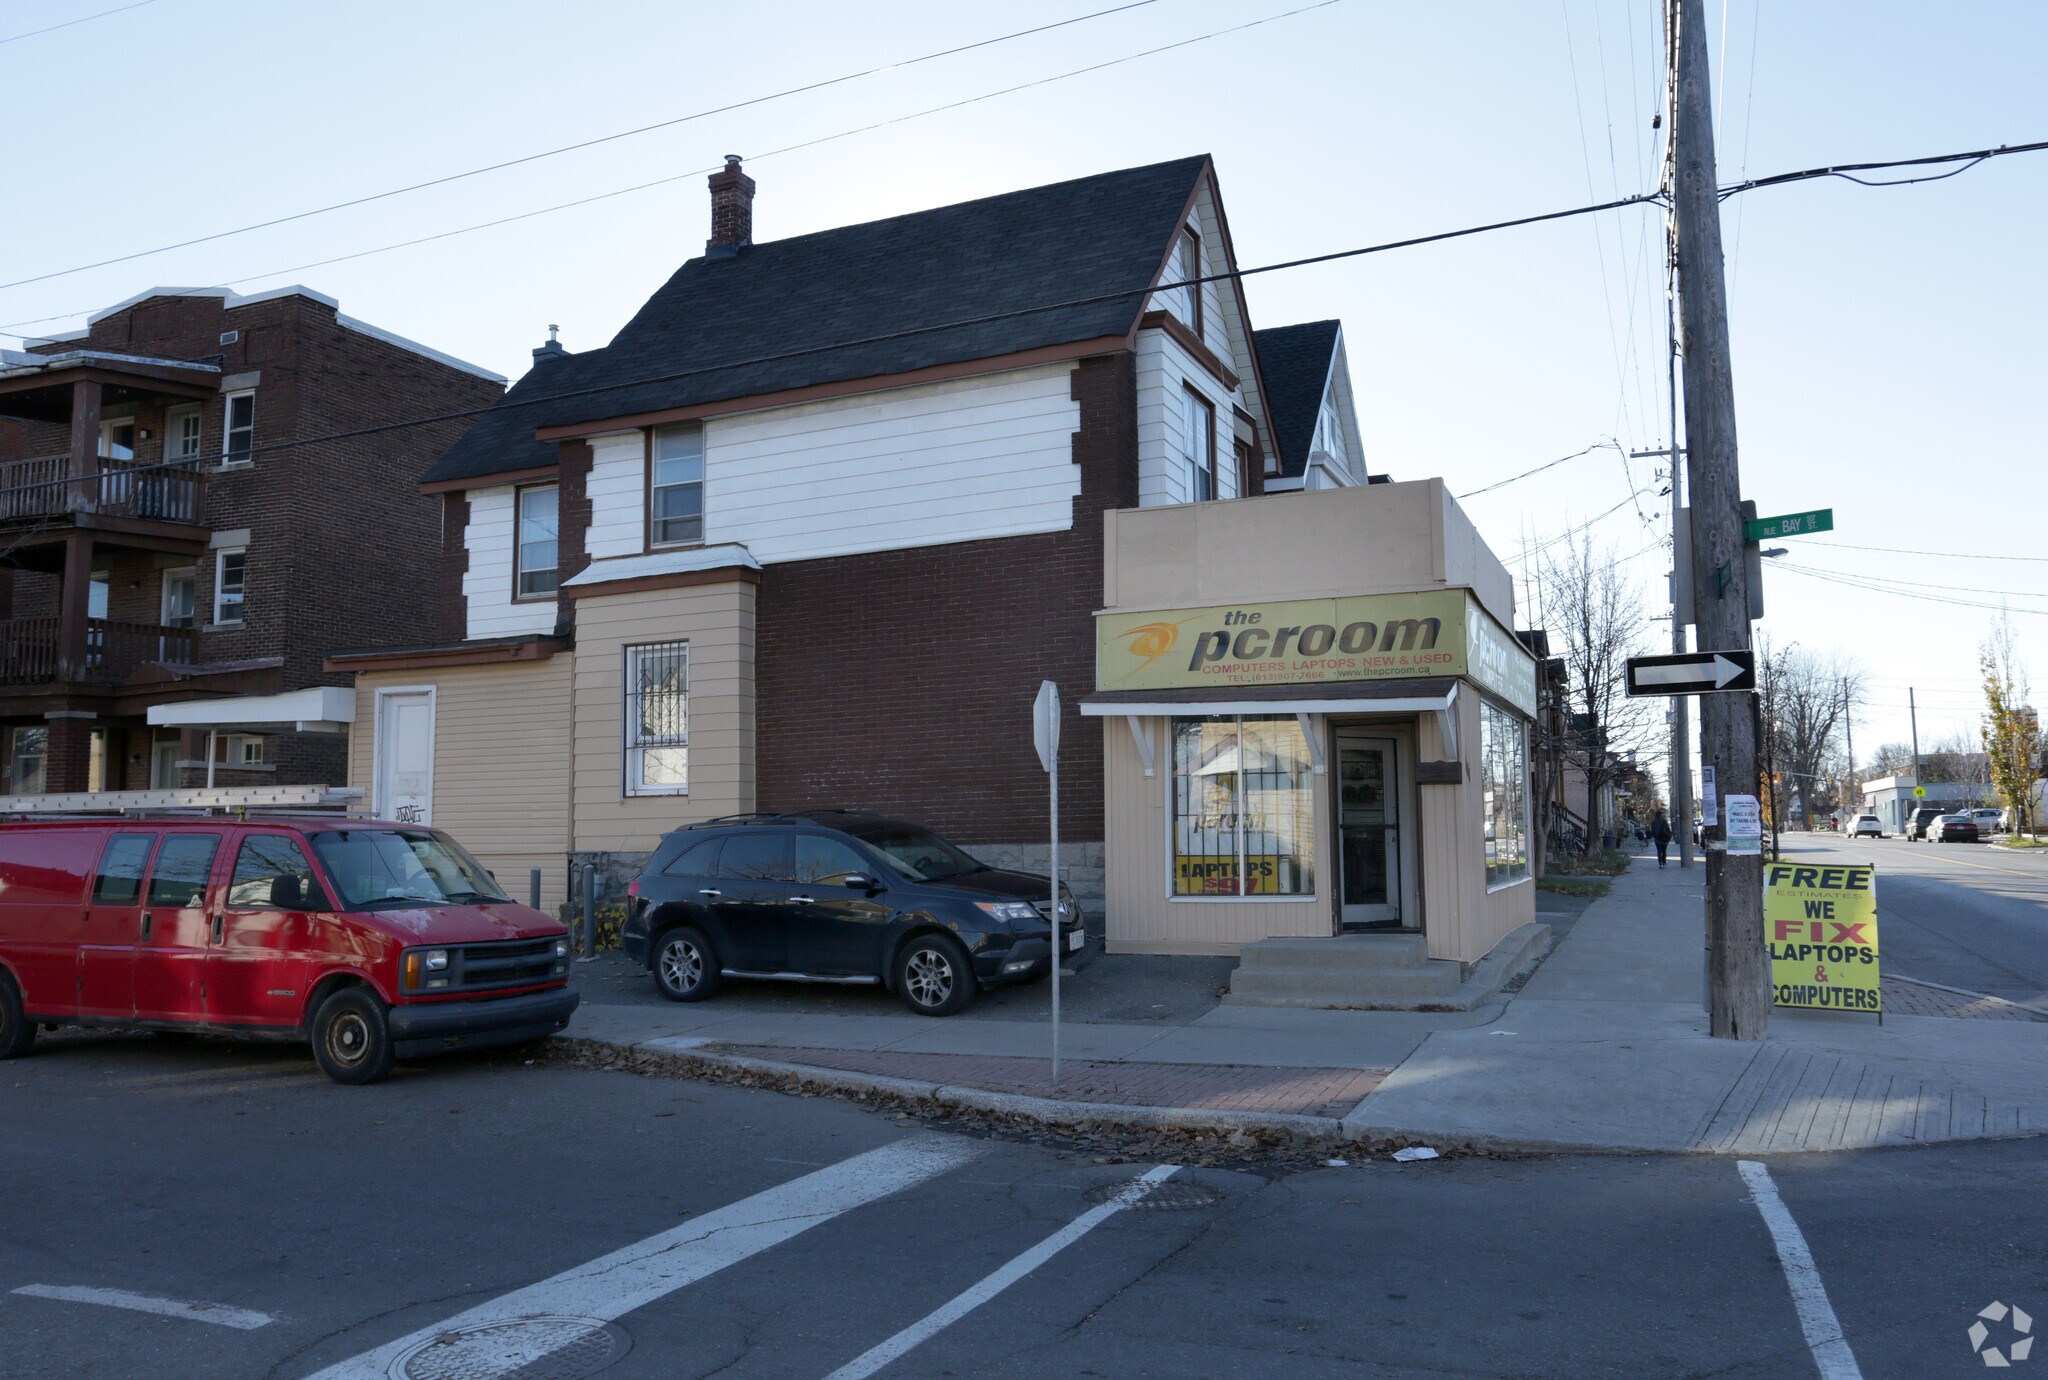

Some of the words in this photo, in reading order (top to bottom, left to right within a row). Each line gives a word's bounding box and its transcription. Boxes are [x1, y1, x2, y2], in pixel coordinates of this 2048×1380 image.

[1764, 527, 1776, 535] RUE
[1782, 518, 1801, 533] BAY
[1224, 610, 1262, 625] the
[1188, 617, 1441, 671] pcroom
[1202, 661, 1286, 674] COMPUTERS
[1293, 658, 1356, 670] LAPTOPS
[1363, 656, 1395, 667] NEW
[1400, 656, 1409, 664] &
[1413, 653, 1453, 664] USED
[1338, 666, 1430, 677] www.thepcroom.ca
[1227, 674, 1249, 682] TEL:
[1181, 862, 1273, 878] LAPTOPS
[1769, 867, 1871, 890] FREE
[1776, 890, 1863, 899] ESTIMATES
[1804, 900, 1835, 919] WE
[1775, 920, 1870, 944] FIX
[1770, 943, 1874, 964] LAPTOPS
[1814, 965, 1828, 982] &
